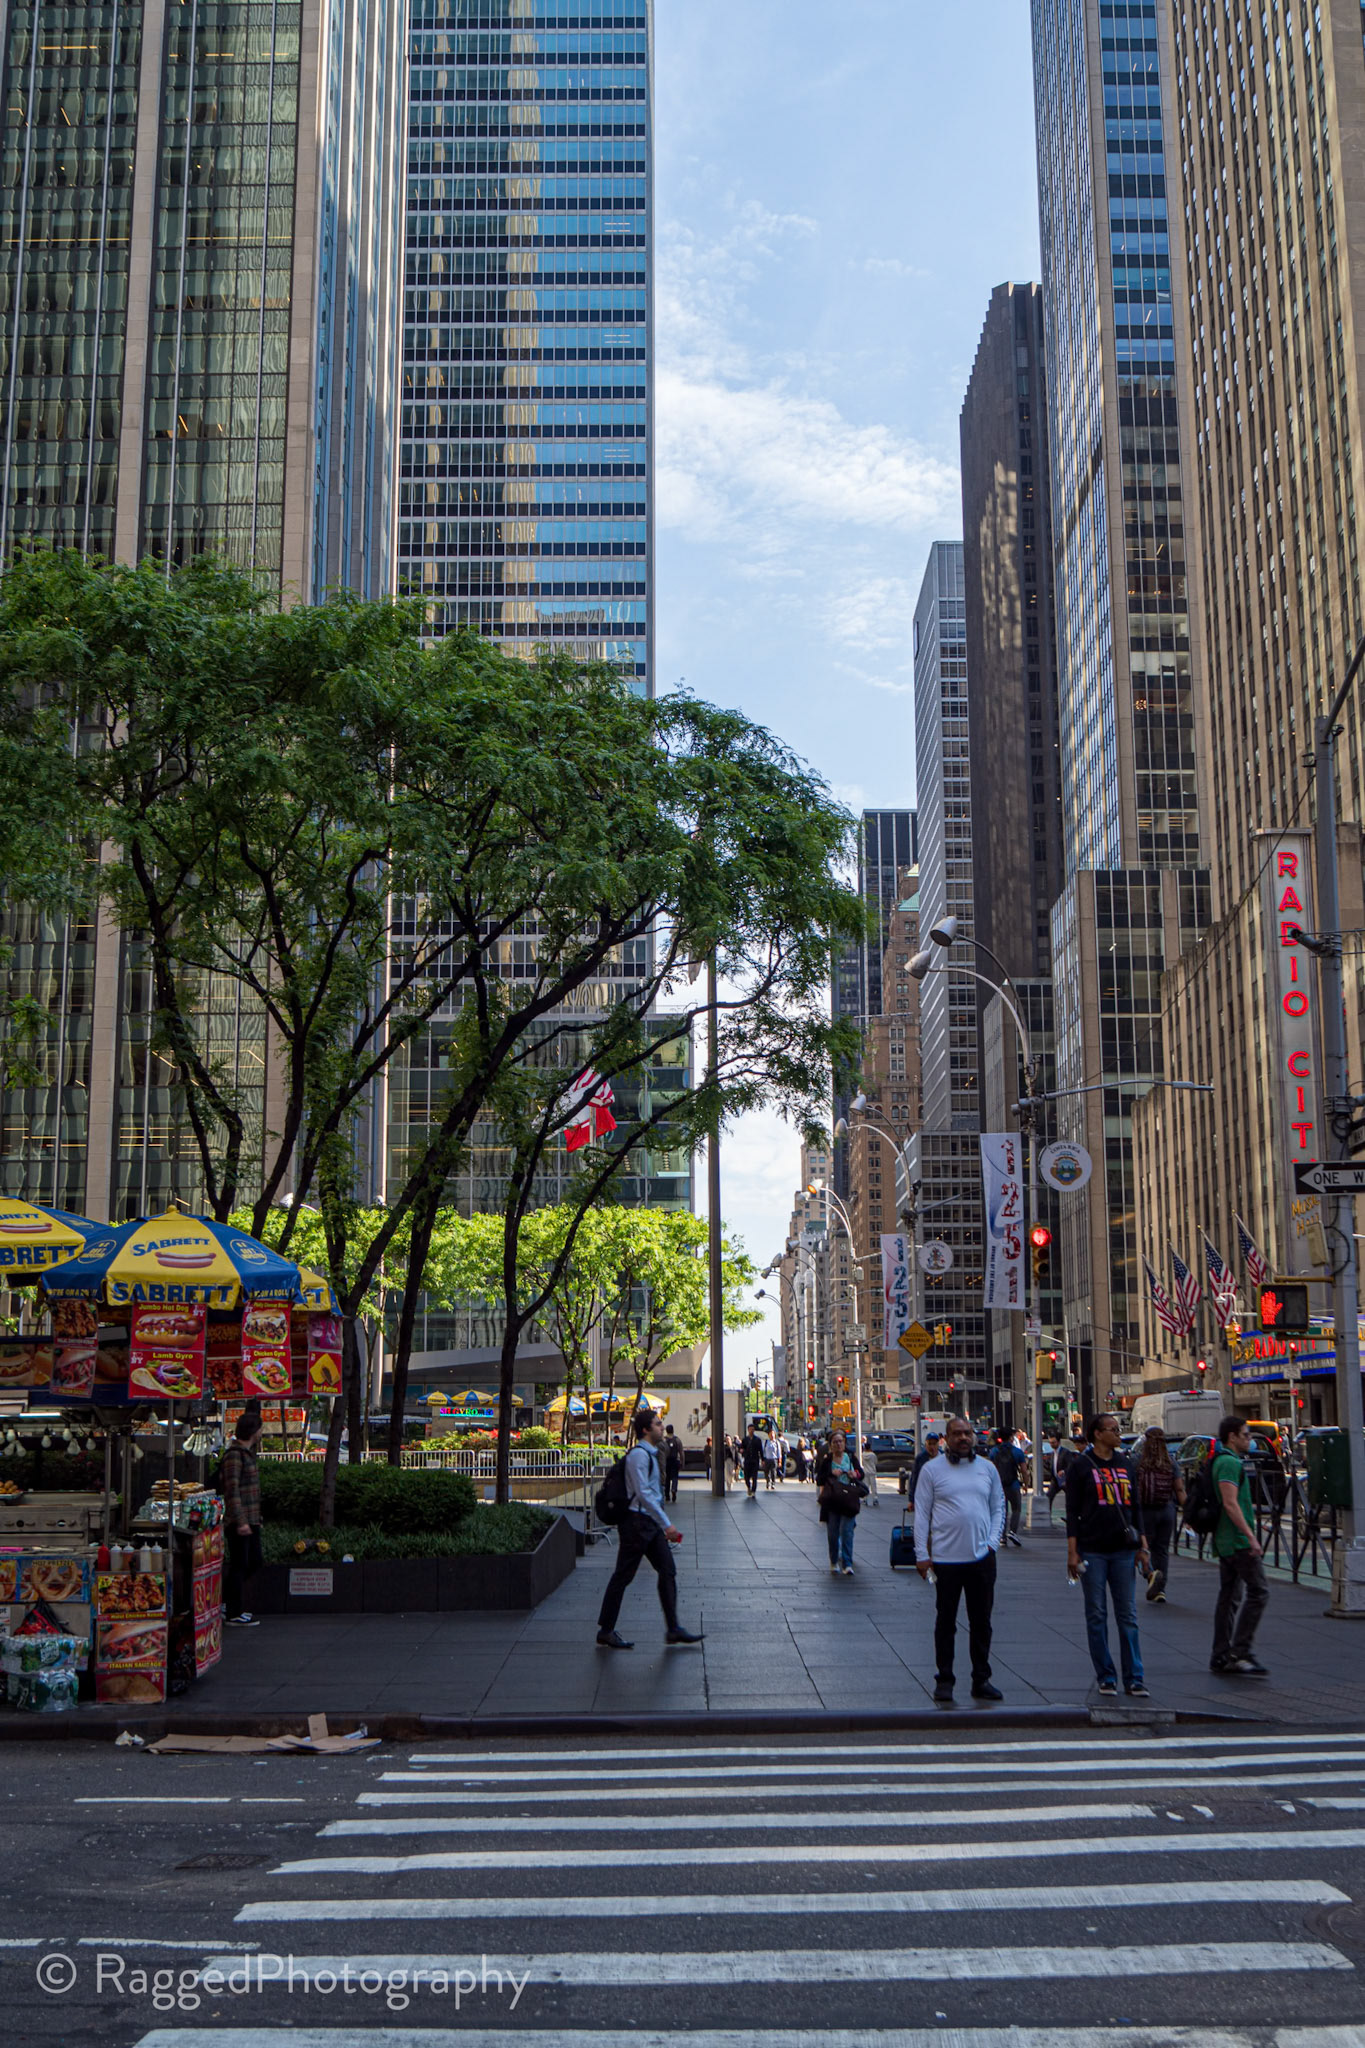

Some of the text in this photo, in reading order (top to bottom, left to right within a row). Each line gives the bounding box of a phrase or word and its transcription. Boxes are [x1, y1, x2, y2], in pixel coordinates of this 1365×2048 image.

[1277, 851, 1317, 1163] RADIO CIT
[1313, 1171, 1340, 1185] ONE
[132, 1238, 210, 1257] SABRETT
[113, 1282, 233, 1303] SABRETT
[175, 1352, 193, 1360] Gyro
[1254, 1335, 1286, 1360] RADIO
[1047, 1402, 1059, 1412] TD
